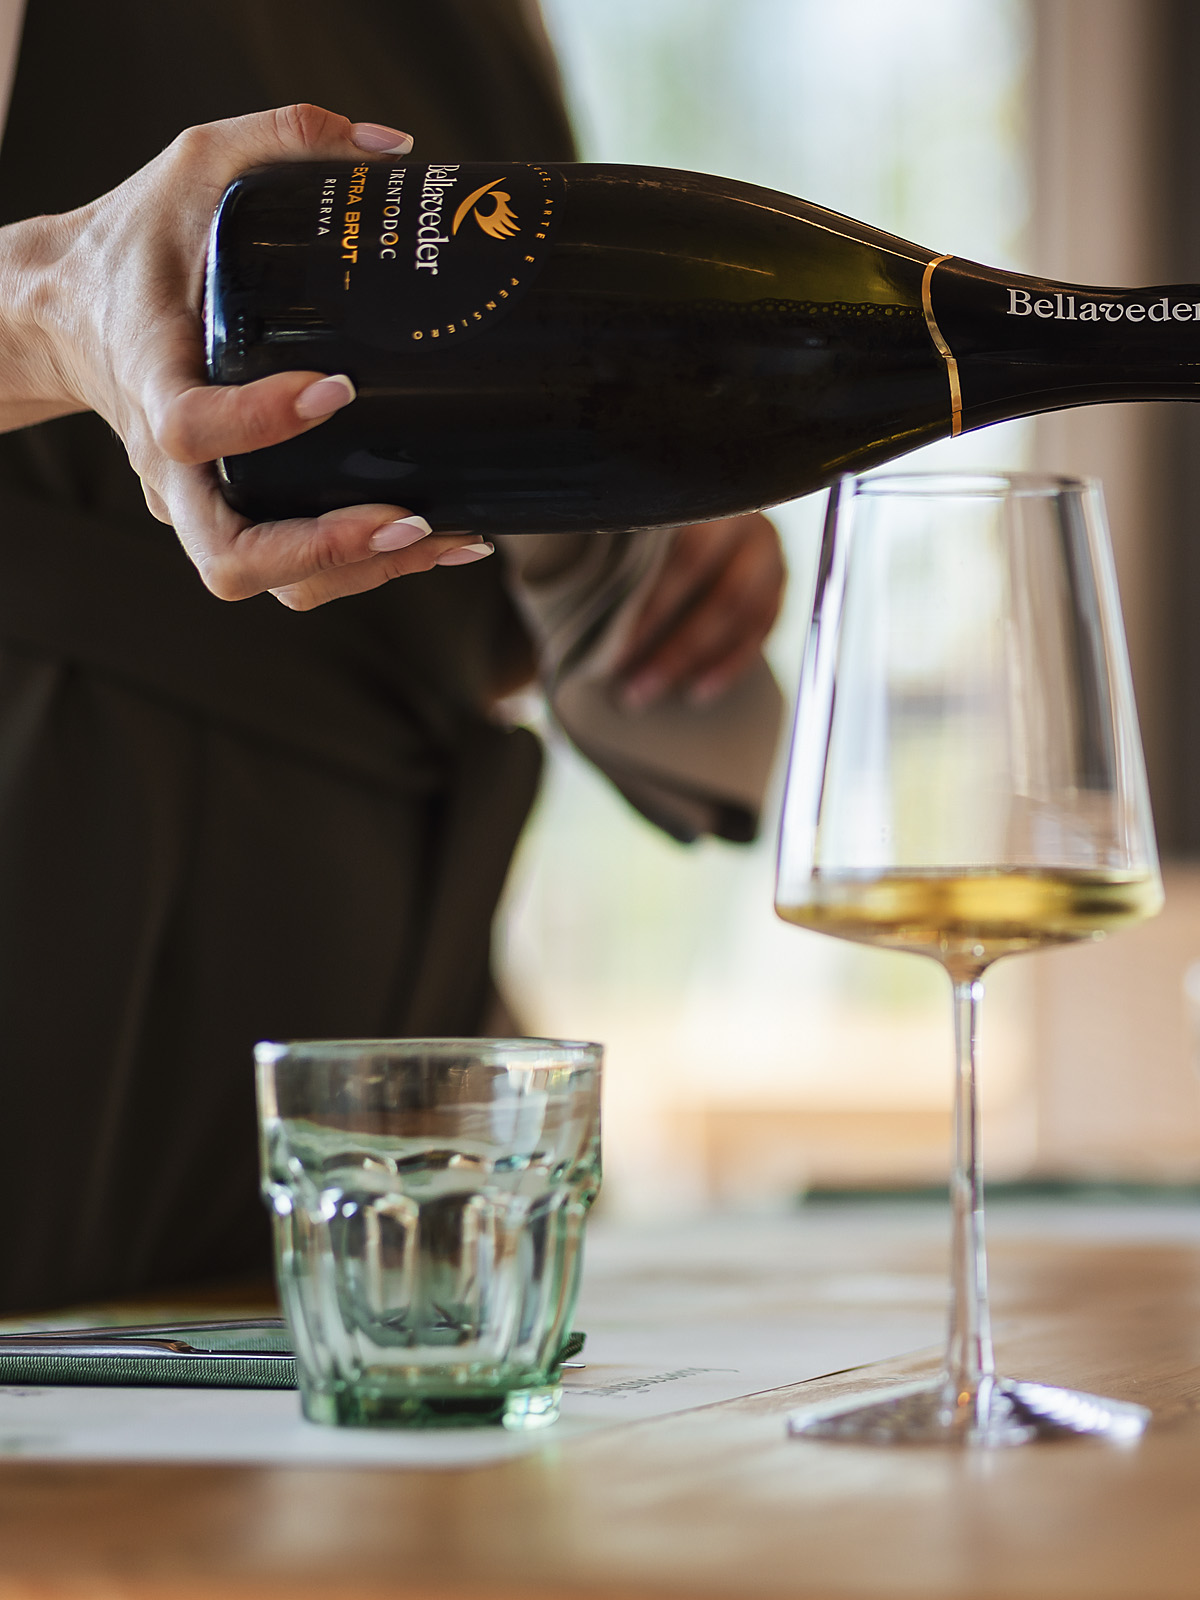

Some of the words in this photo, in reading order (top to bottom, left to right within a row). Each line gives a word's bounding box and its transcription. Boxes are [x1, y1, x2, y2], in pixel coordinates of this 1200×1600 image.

[316, 178, 337, 236] RISERVA
[346, 165, 369, 206] EXTRA
[341, 211, 361, 264] BRUT
[379, 168, 407, 260] TRENTODOC
[415, 164, 460, 276] Bellaveder
[536, 198, 554, 240] ARTE
[524, 255, 535, 263] E
[412, 277, 520, 341] PENSIERO
